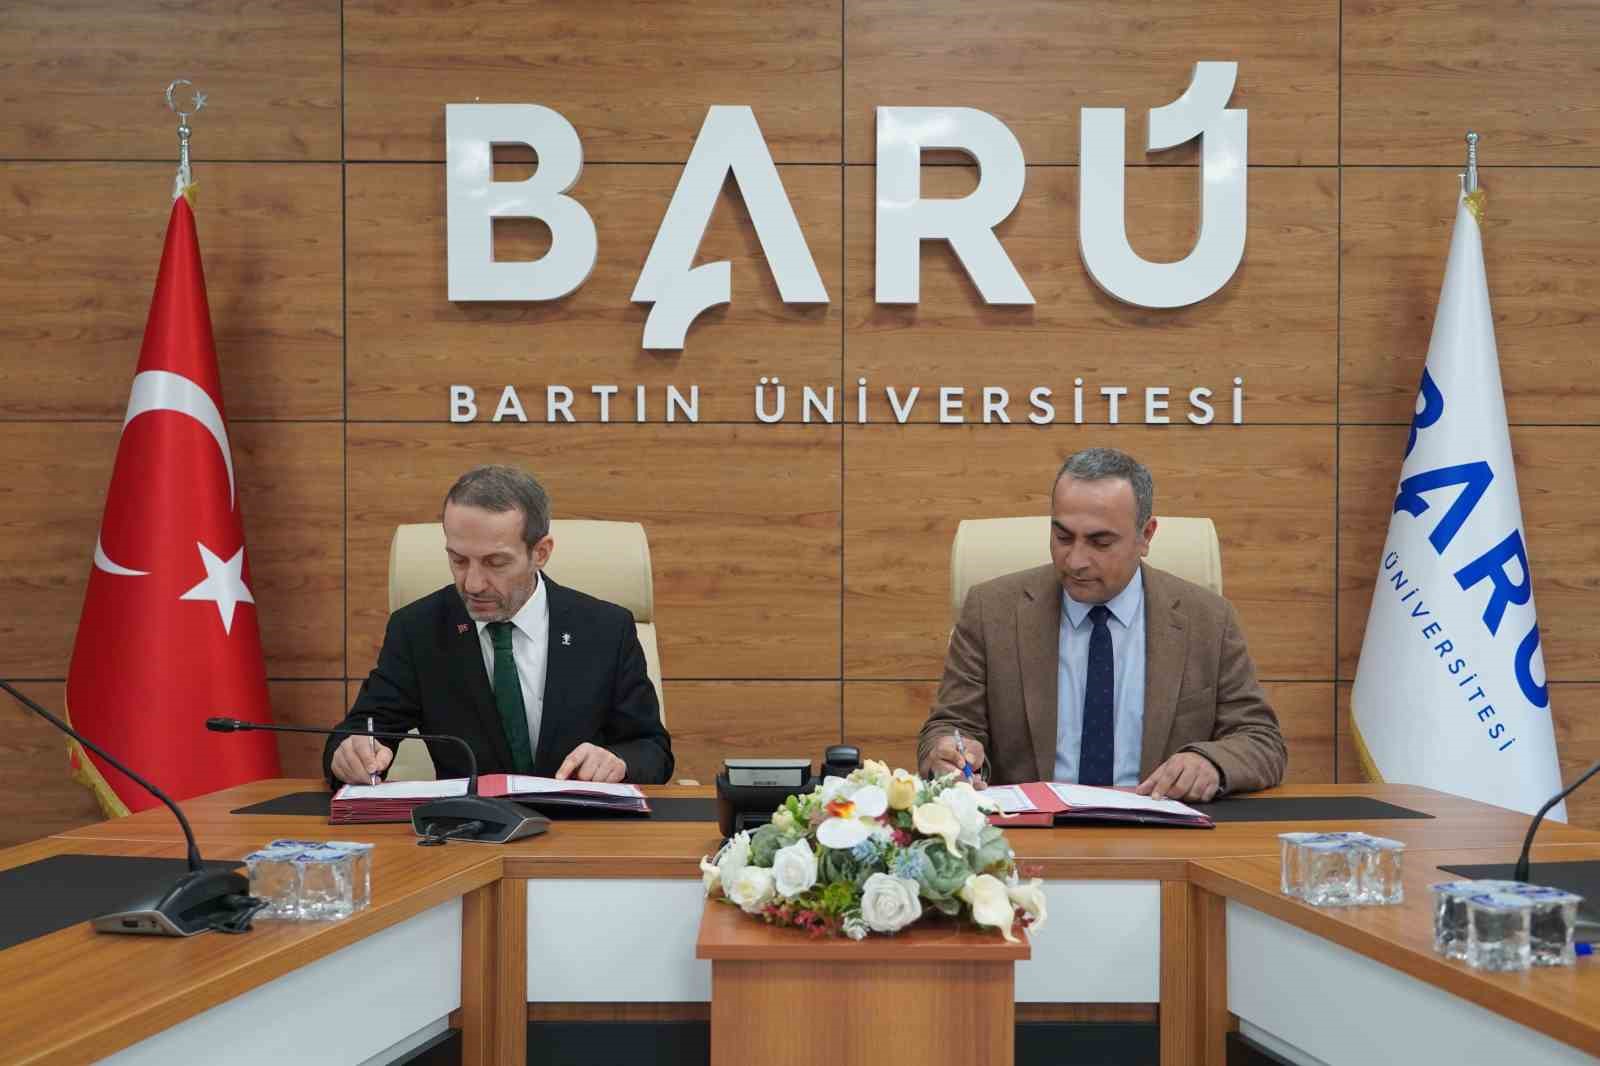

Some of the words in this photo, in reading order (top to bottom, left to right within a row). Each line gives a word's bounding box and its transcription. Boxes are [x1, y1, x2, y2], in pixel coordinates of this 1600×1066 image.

[449, 385, 700, 423] BARTIN
[755, 376, 1245, 424] ÜNİVERSİTESİ
[1385, 551, 1517, 752] ÜNİVERSİTESİ
